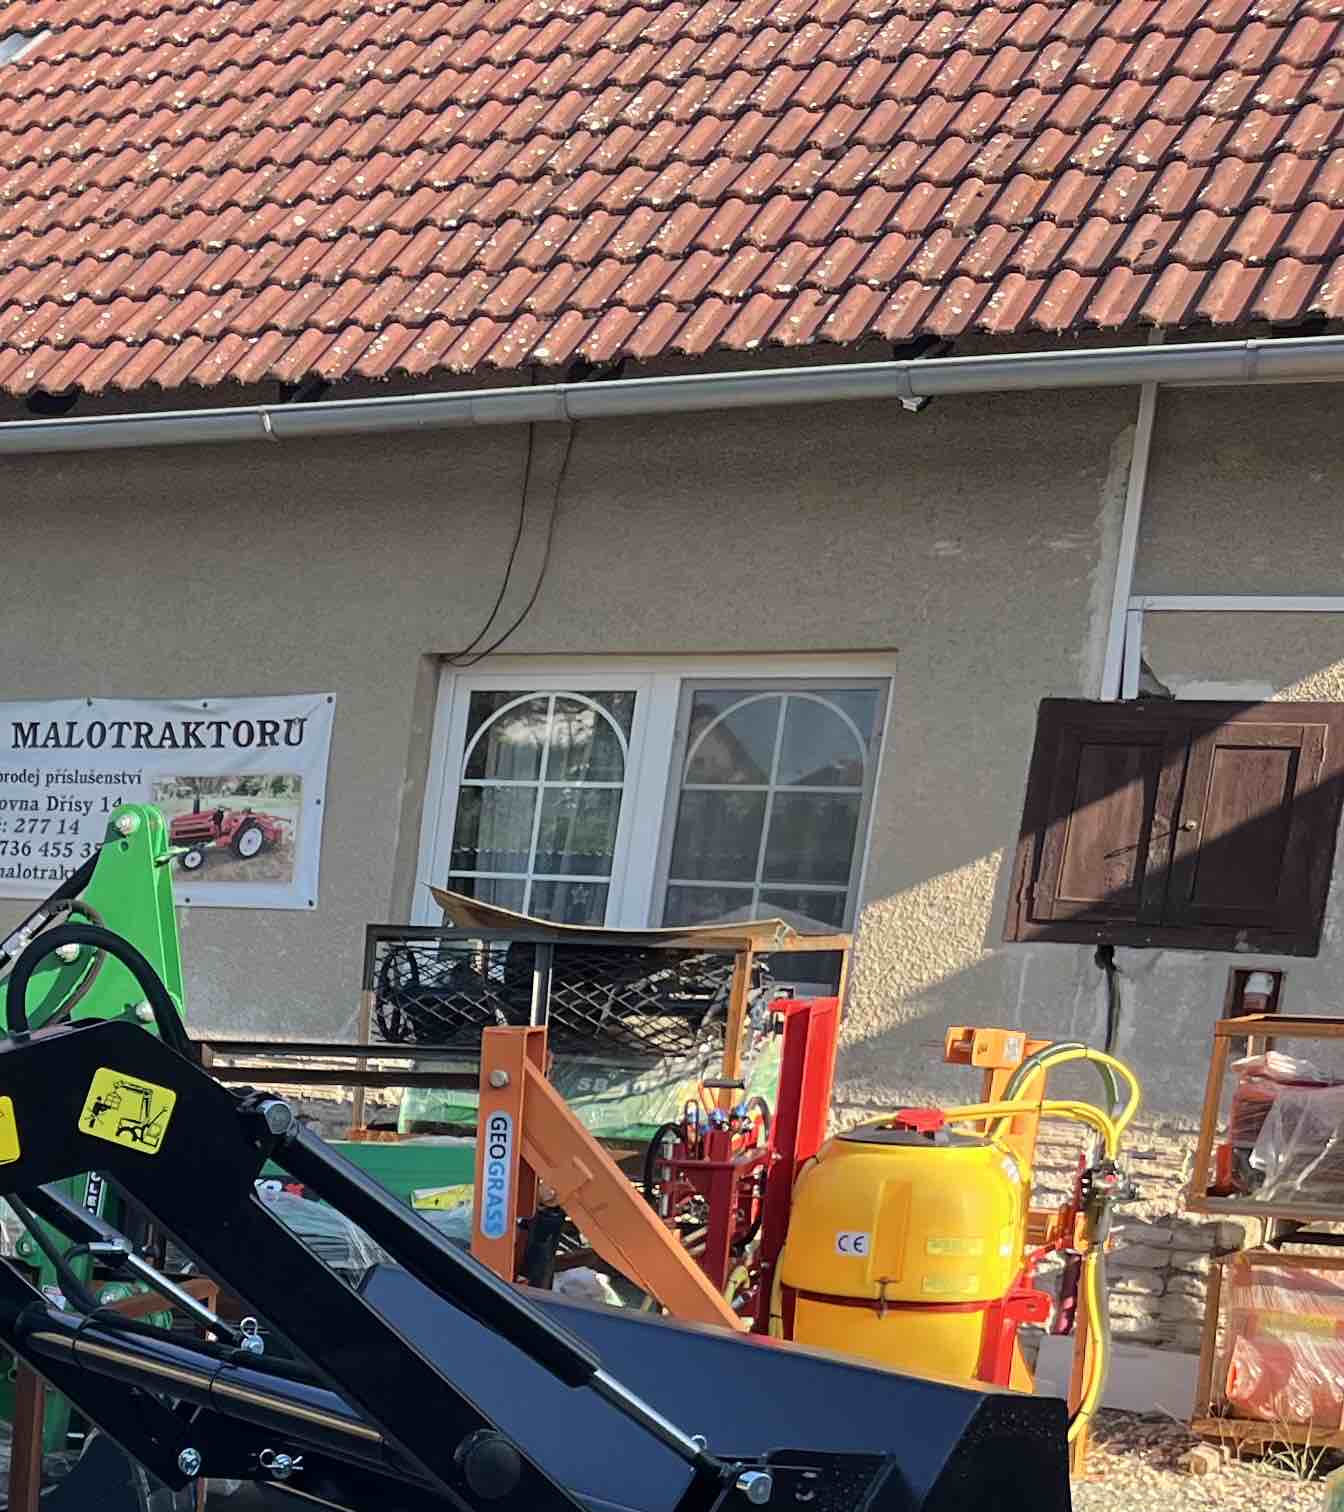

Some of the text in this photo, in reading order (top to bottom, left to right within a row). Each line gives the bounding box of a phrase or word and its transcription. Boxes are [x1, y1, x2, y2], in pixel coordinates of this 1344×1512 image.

[47, 794, 93, 816] Dřísy
[13, 818, 52, 835] 277
[57, 818, 80, 835] 14
[0, 839, 32, 857] 736
[38, 841, 74, 858] 455
[485, 1116, 509, 1234] GEOGRASS
[838, 1234, 865, 1253] CE
